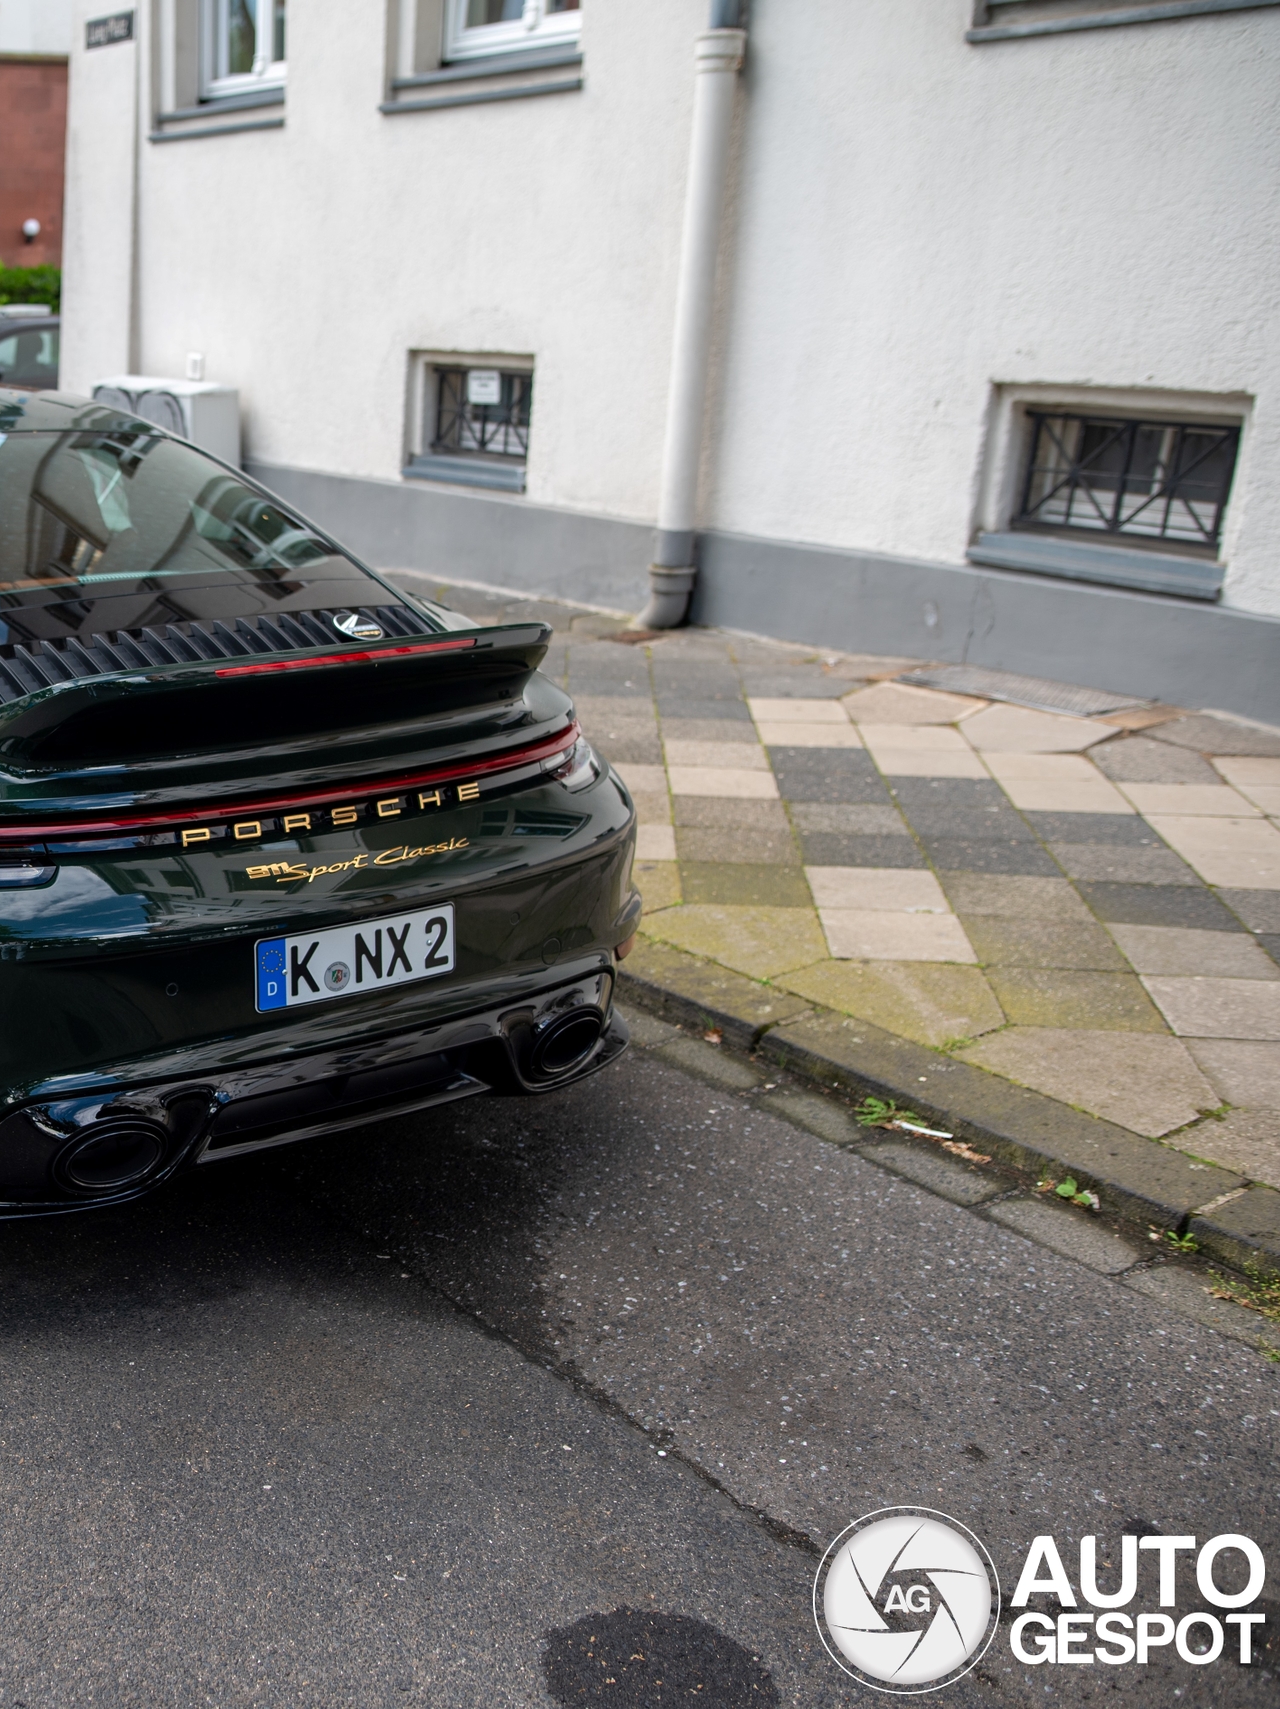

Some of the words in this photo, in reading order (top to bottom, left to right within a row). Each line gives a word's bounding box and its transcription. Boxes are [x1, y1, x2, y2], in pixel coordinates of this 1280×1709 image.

[181, 782, 480, 847] PORSCHE
[275, 854, 369, 882] Sport
[373, 837, 469, 866] Classic
[291, 941, 320, 996] K
[355, 922, 412, 983] NX
[425, 916, 448, 969] 2
[267, 982, 278, 996] D
